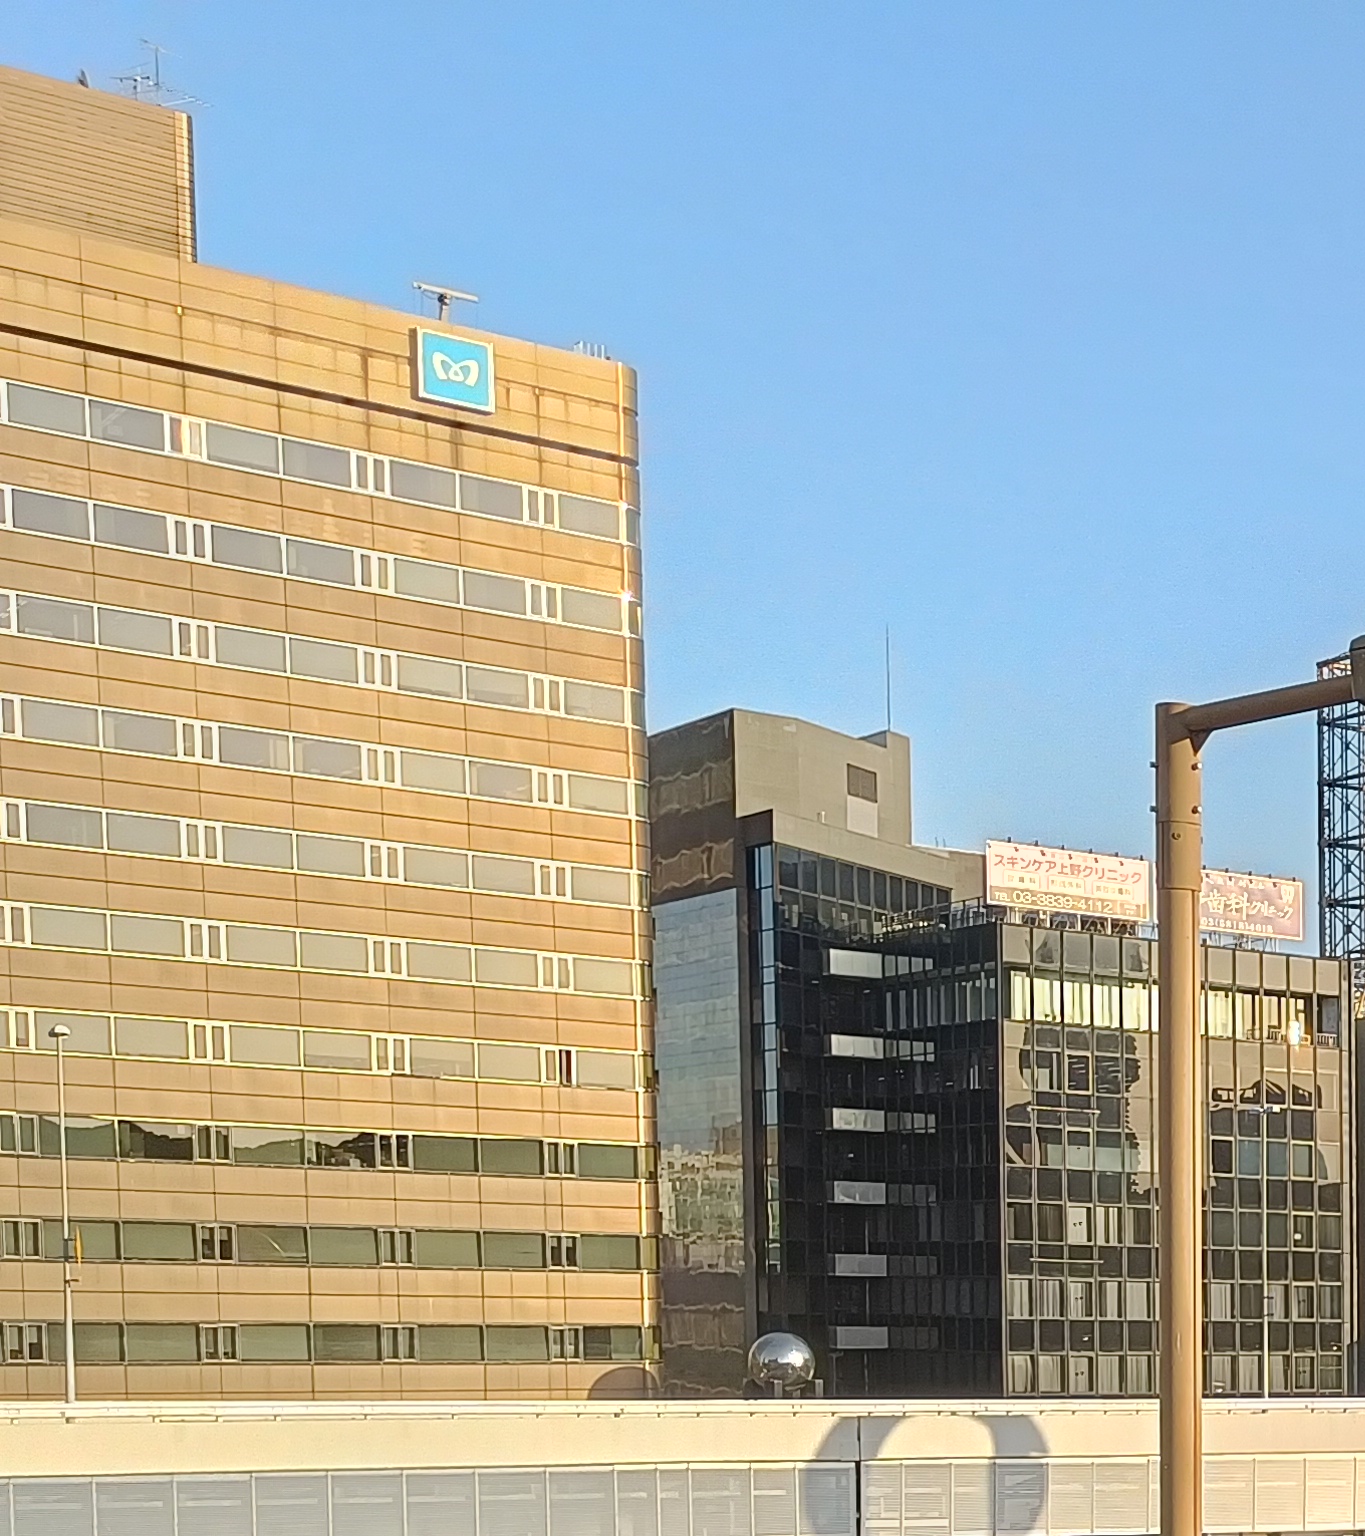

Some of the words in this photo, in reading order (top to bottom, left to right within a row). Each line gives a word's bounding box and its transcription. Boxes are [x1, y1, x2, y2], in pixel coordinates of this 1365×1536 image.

[993, 854, 1143, 884] スキンケア上野クリニック
[1012, 890, 1114, 914] 03-3839-4112
